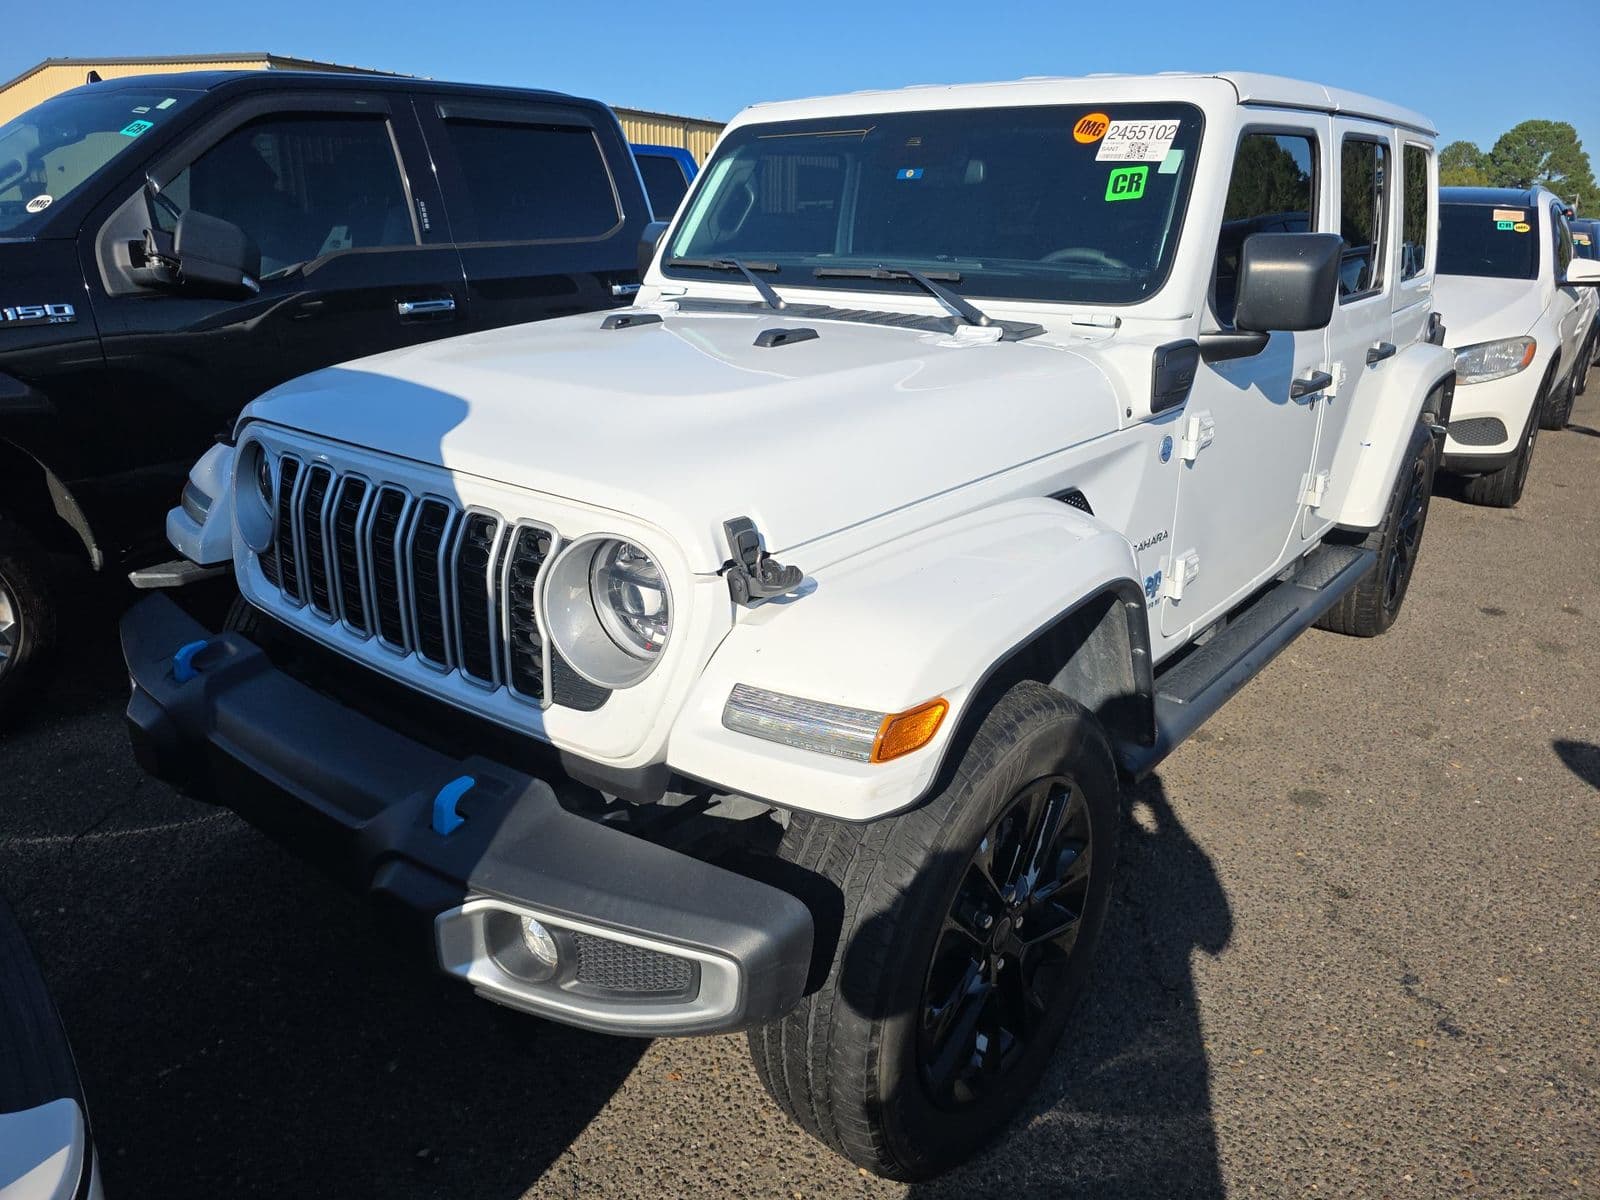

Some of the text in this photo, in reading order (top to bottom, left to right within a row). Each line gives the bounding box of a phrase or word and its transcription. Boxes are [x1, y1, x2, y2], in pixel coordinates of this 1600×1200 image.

[126, 123, 147, 135] CR
[1076, 119, 1105, 137] IMG
[1107, 124, 1177, 140] 2455102
[1111, 172, 1143, 194] CR
[29, 199, 50, 209] IMG
